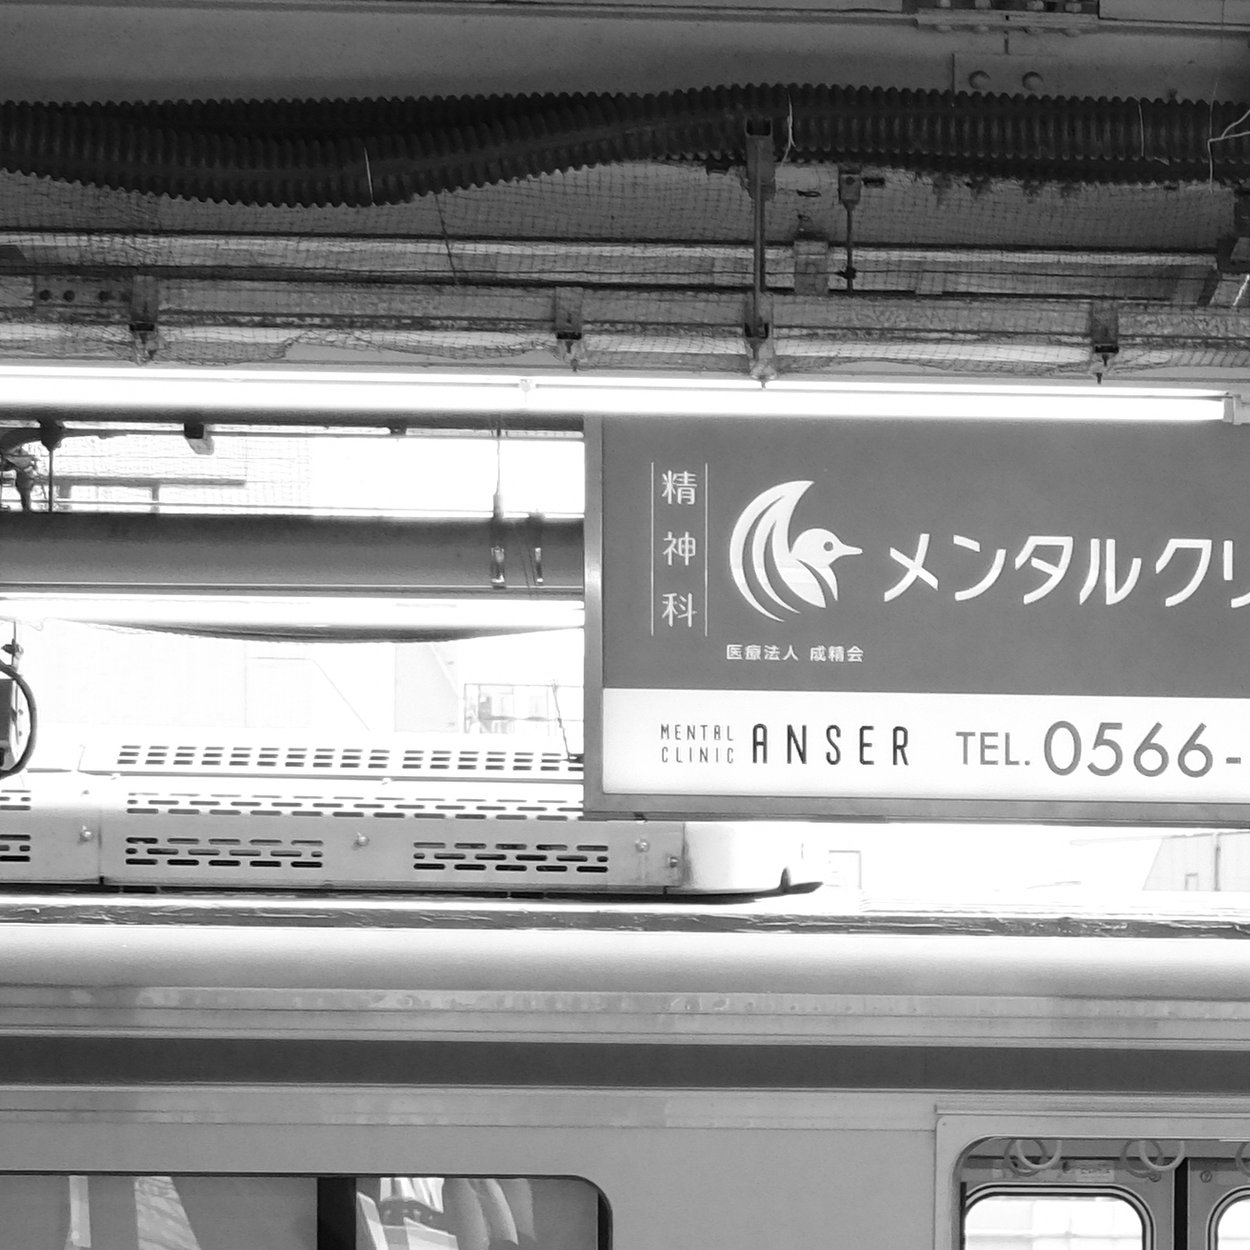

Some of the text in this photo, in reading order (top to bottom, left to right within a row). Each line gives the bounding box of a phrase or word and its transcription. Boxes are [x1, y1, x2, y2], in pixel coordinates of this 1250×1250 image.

[662, 470, 697, 627] 精神科
[726, 644, 799, 661] 医療法人
[661, 724, 733, 742] MENTAL
[752, 724, 908, 766] ANSER
[662, 747, 734, 764] CLINIC
